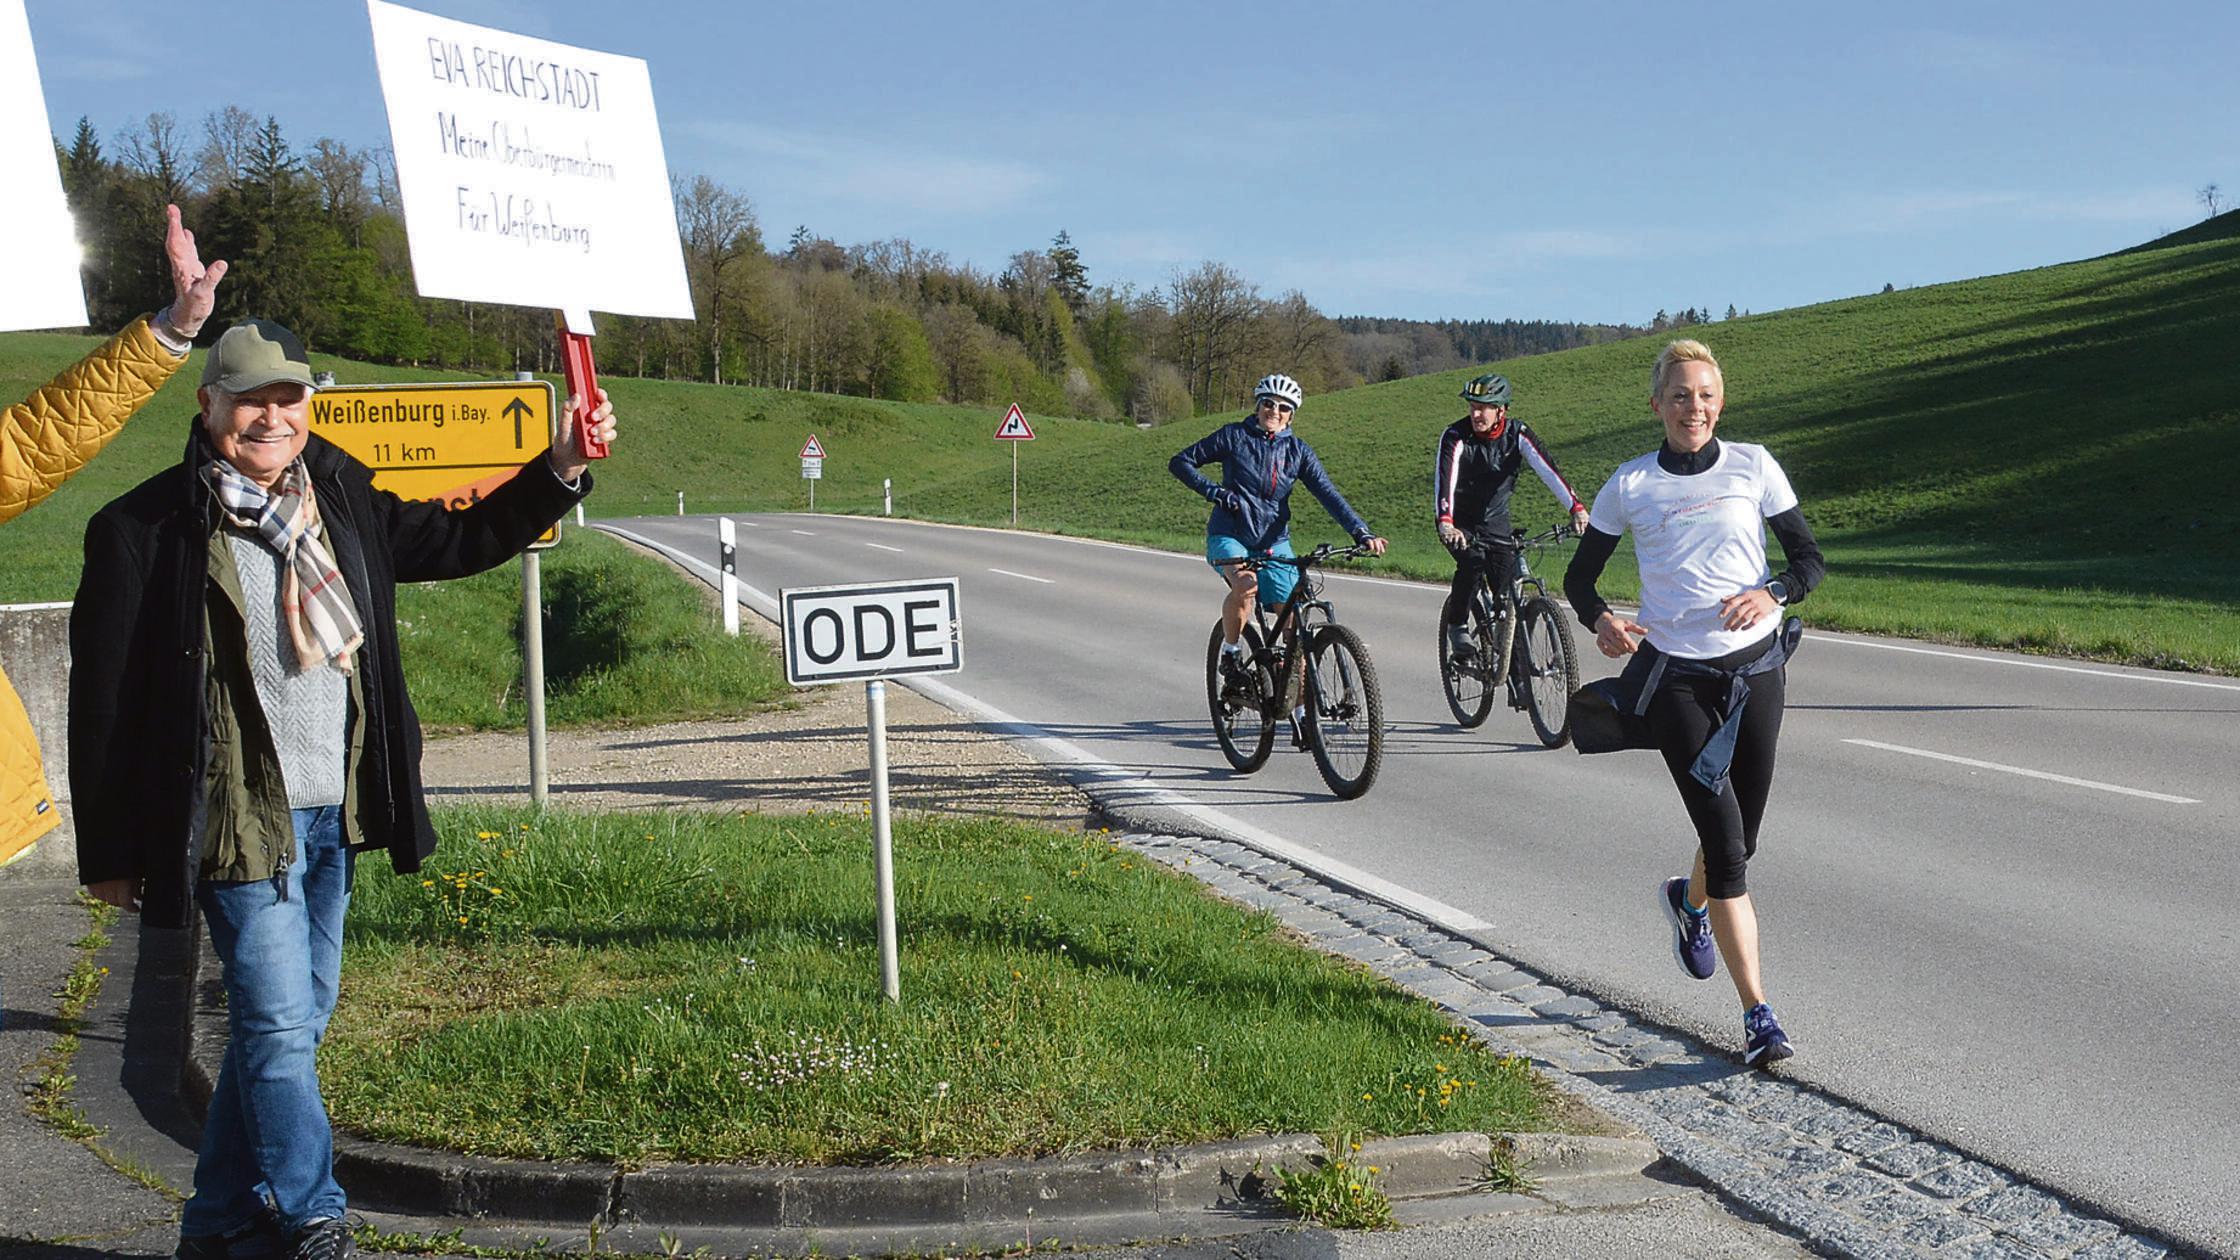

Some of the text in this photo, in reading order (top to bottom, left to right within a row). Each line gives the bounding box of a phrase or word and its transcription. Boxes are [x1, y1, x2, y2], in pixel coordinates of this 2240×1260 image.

[427, 37, 600, 112] EVA REICHSTADT
[437, 111, 489, 159] Meine
[456, 186, 489, 232] Für
[312, 399, 491, 428] Weißenburg i.Bay.
[374, 443, 436, 462] 11 km
[803, 600, 943, 665] ODE
